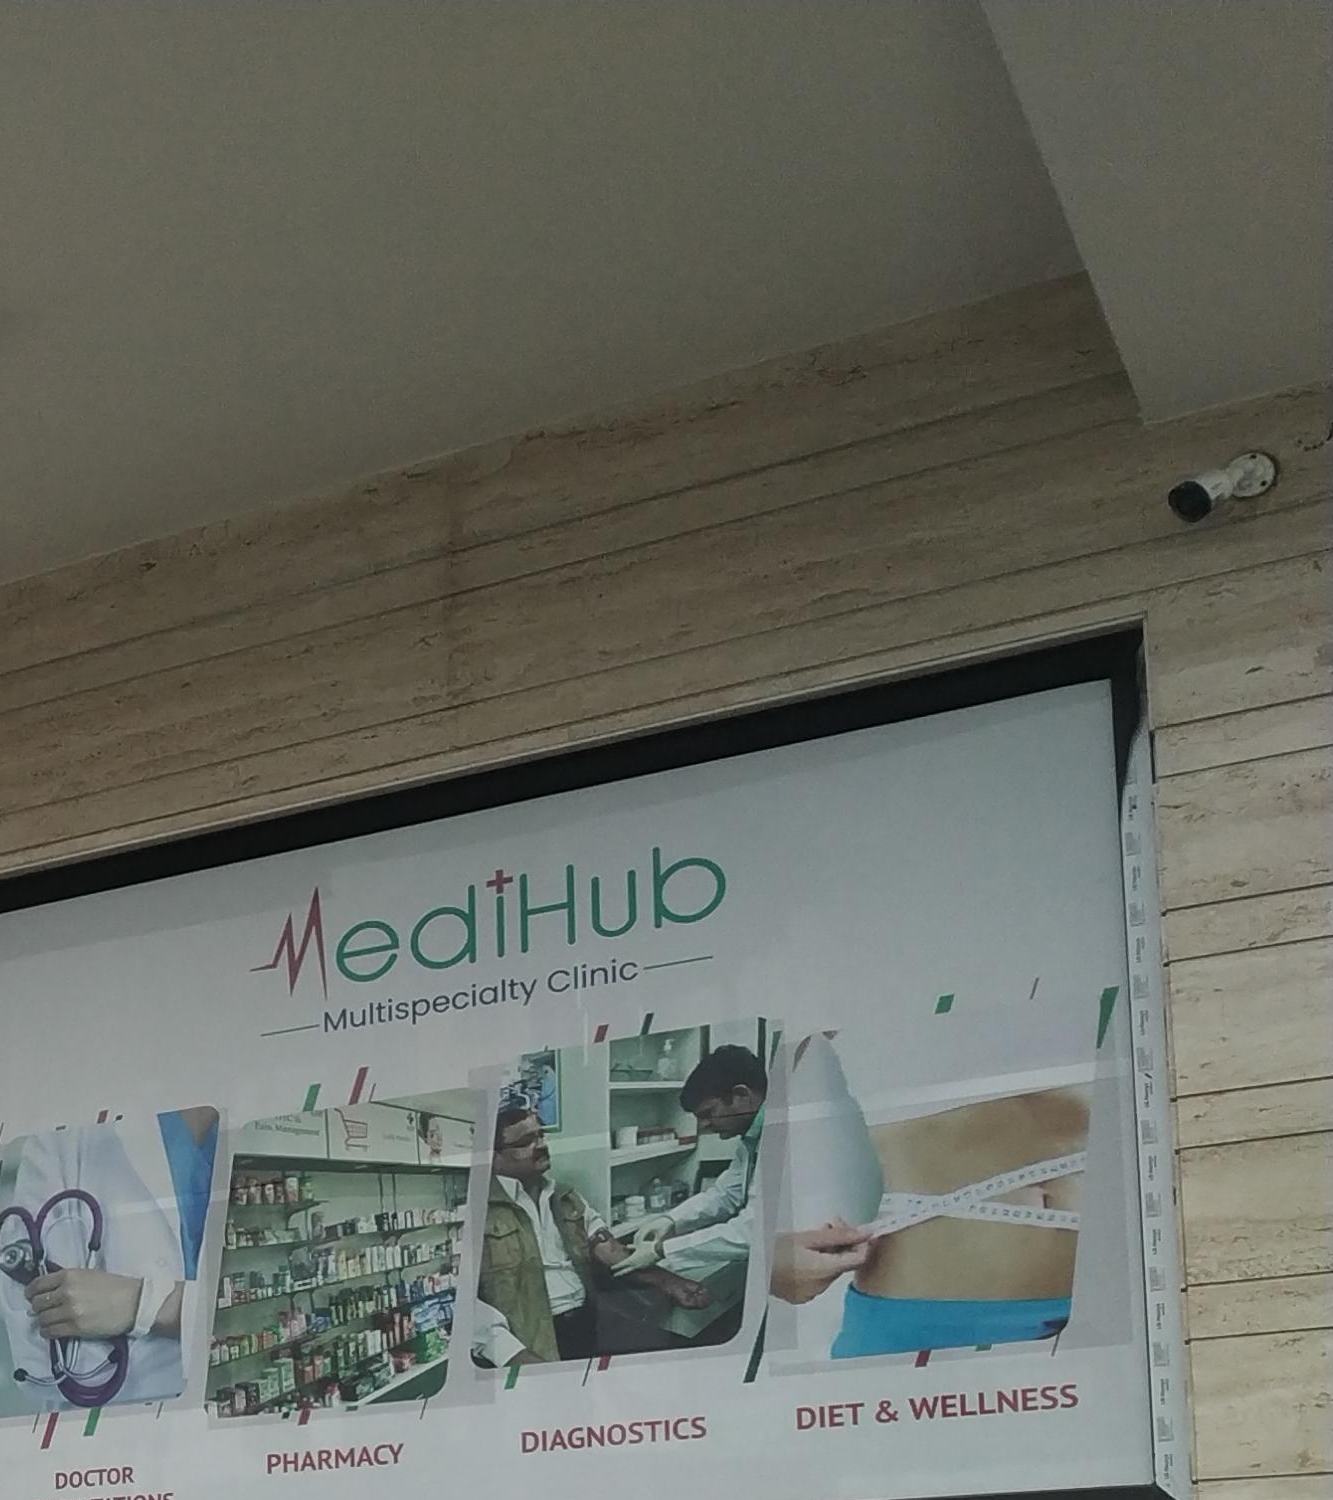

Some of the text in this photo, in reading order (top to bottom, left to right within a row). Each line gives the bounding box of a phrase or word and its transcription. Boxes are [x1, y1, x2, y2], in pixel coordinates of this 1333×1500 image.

[249, 847, 726, 1000] MediHub
[322, 957, 640, 1034] Multispecialty Clinic
[795, 1383, 1081, 1431] DIET & WELLNESS
[519, 1415, 709, 1455] DIAGNOSTICS
[54, 1466, 135, 1491] DOCTOR
[265, 1442, 406, 1476] PHARMACY
